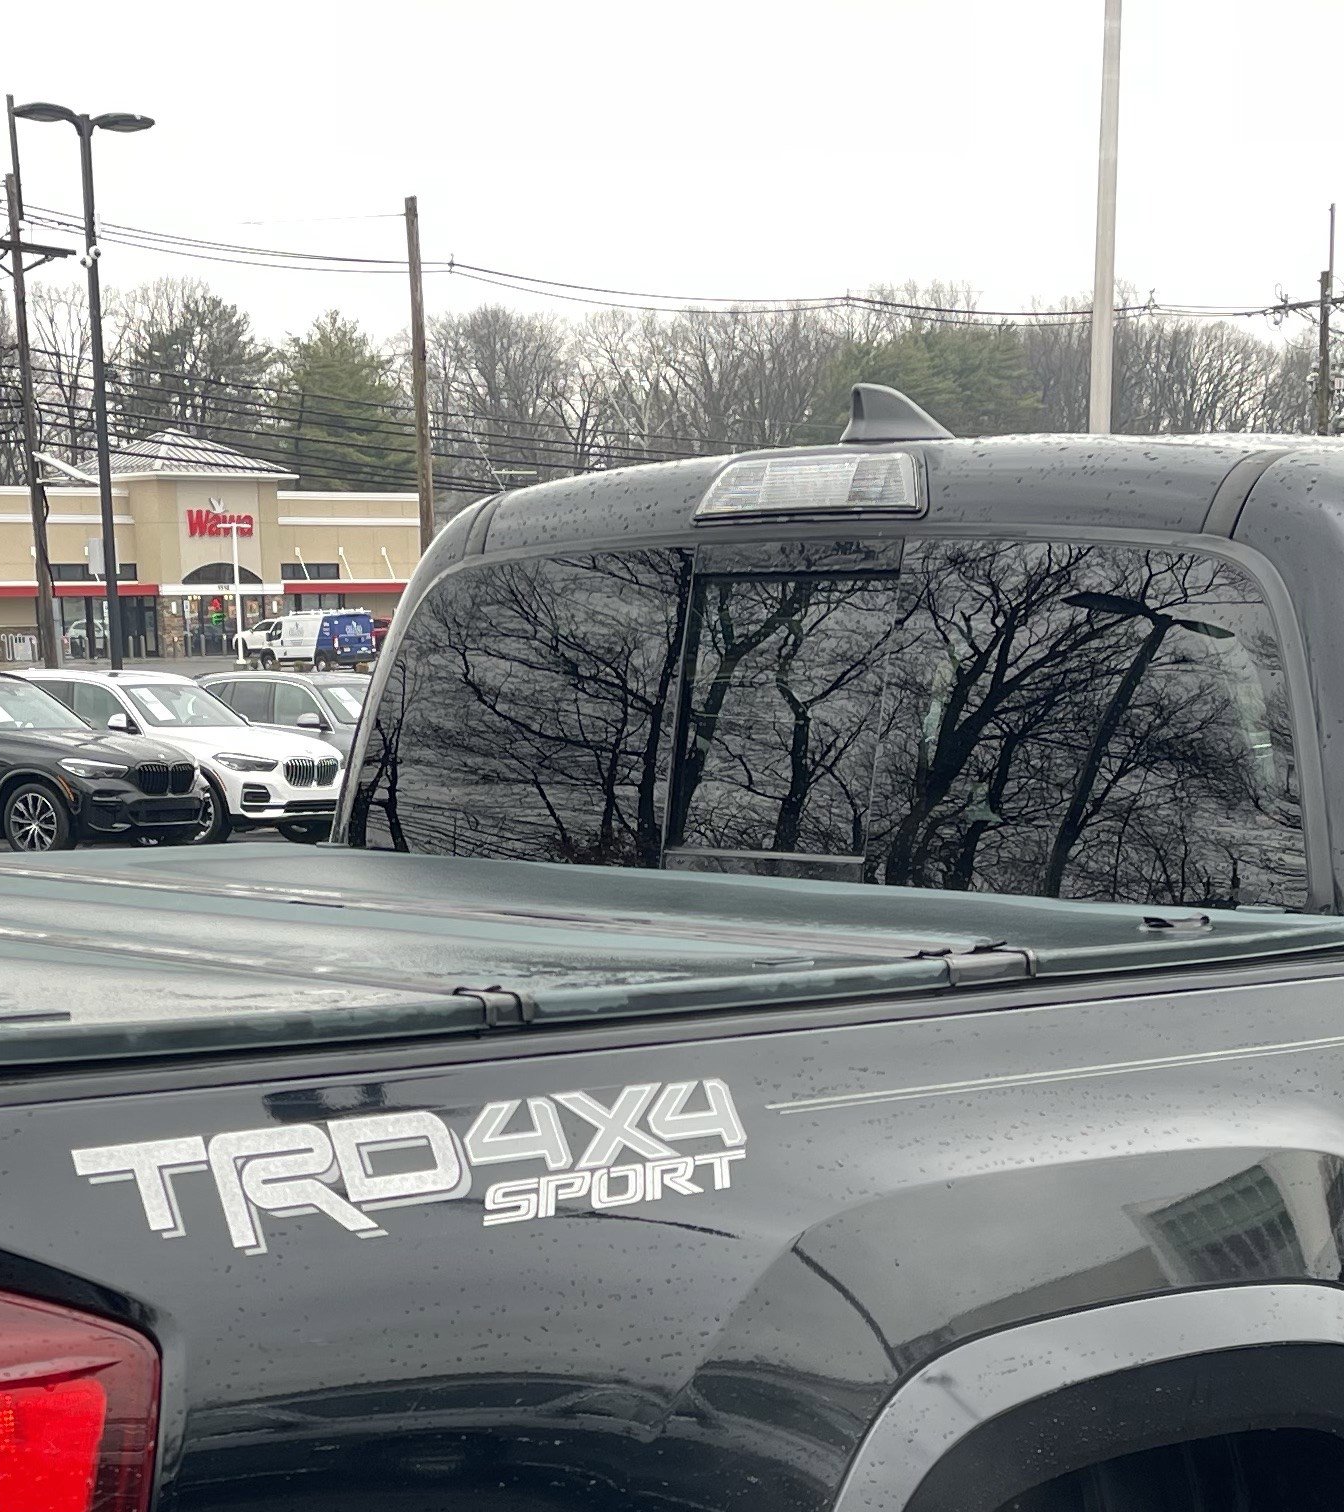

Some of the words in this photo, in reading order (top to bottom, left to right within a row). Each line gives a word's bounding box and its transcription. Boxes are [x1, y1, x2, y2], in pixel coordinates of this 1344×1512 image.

[186, 509, 254, 538] Wawa
[70, 1110, 472, 1256] TRD
[462, 1077, 748, 1171] 4X4
[482, 1149, 747, 1227] SPORT
